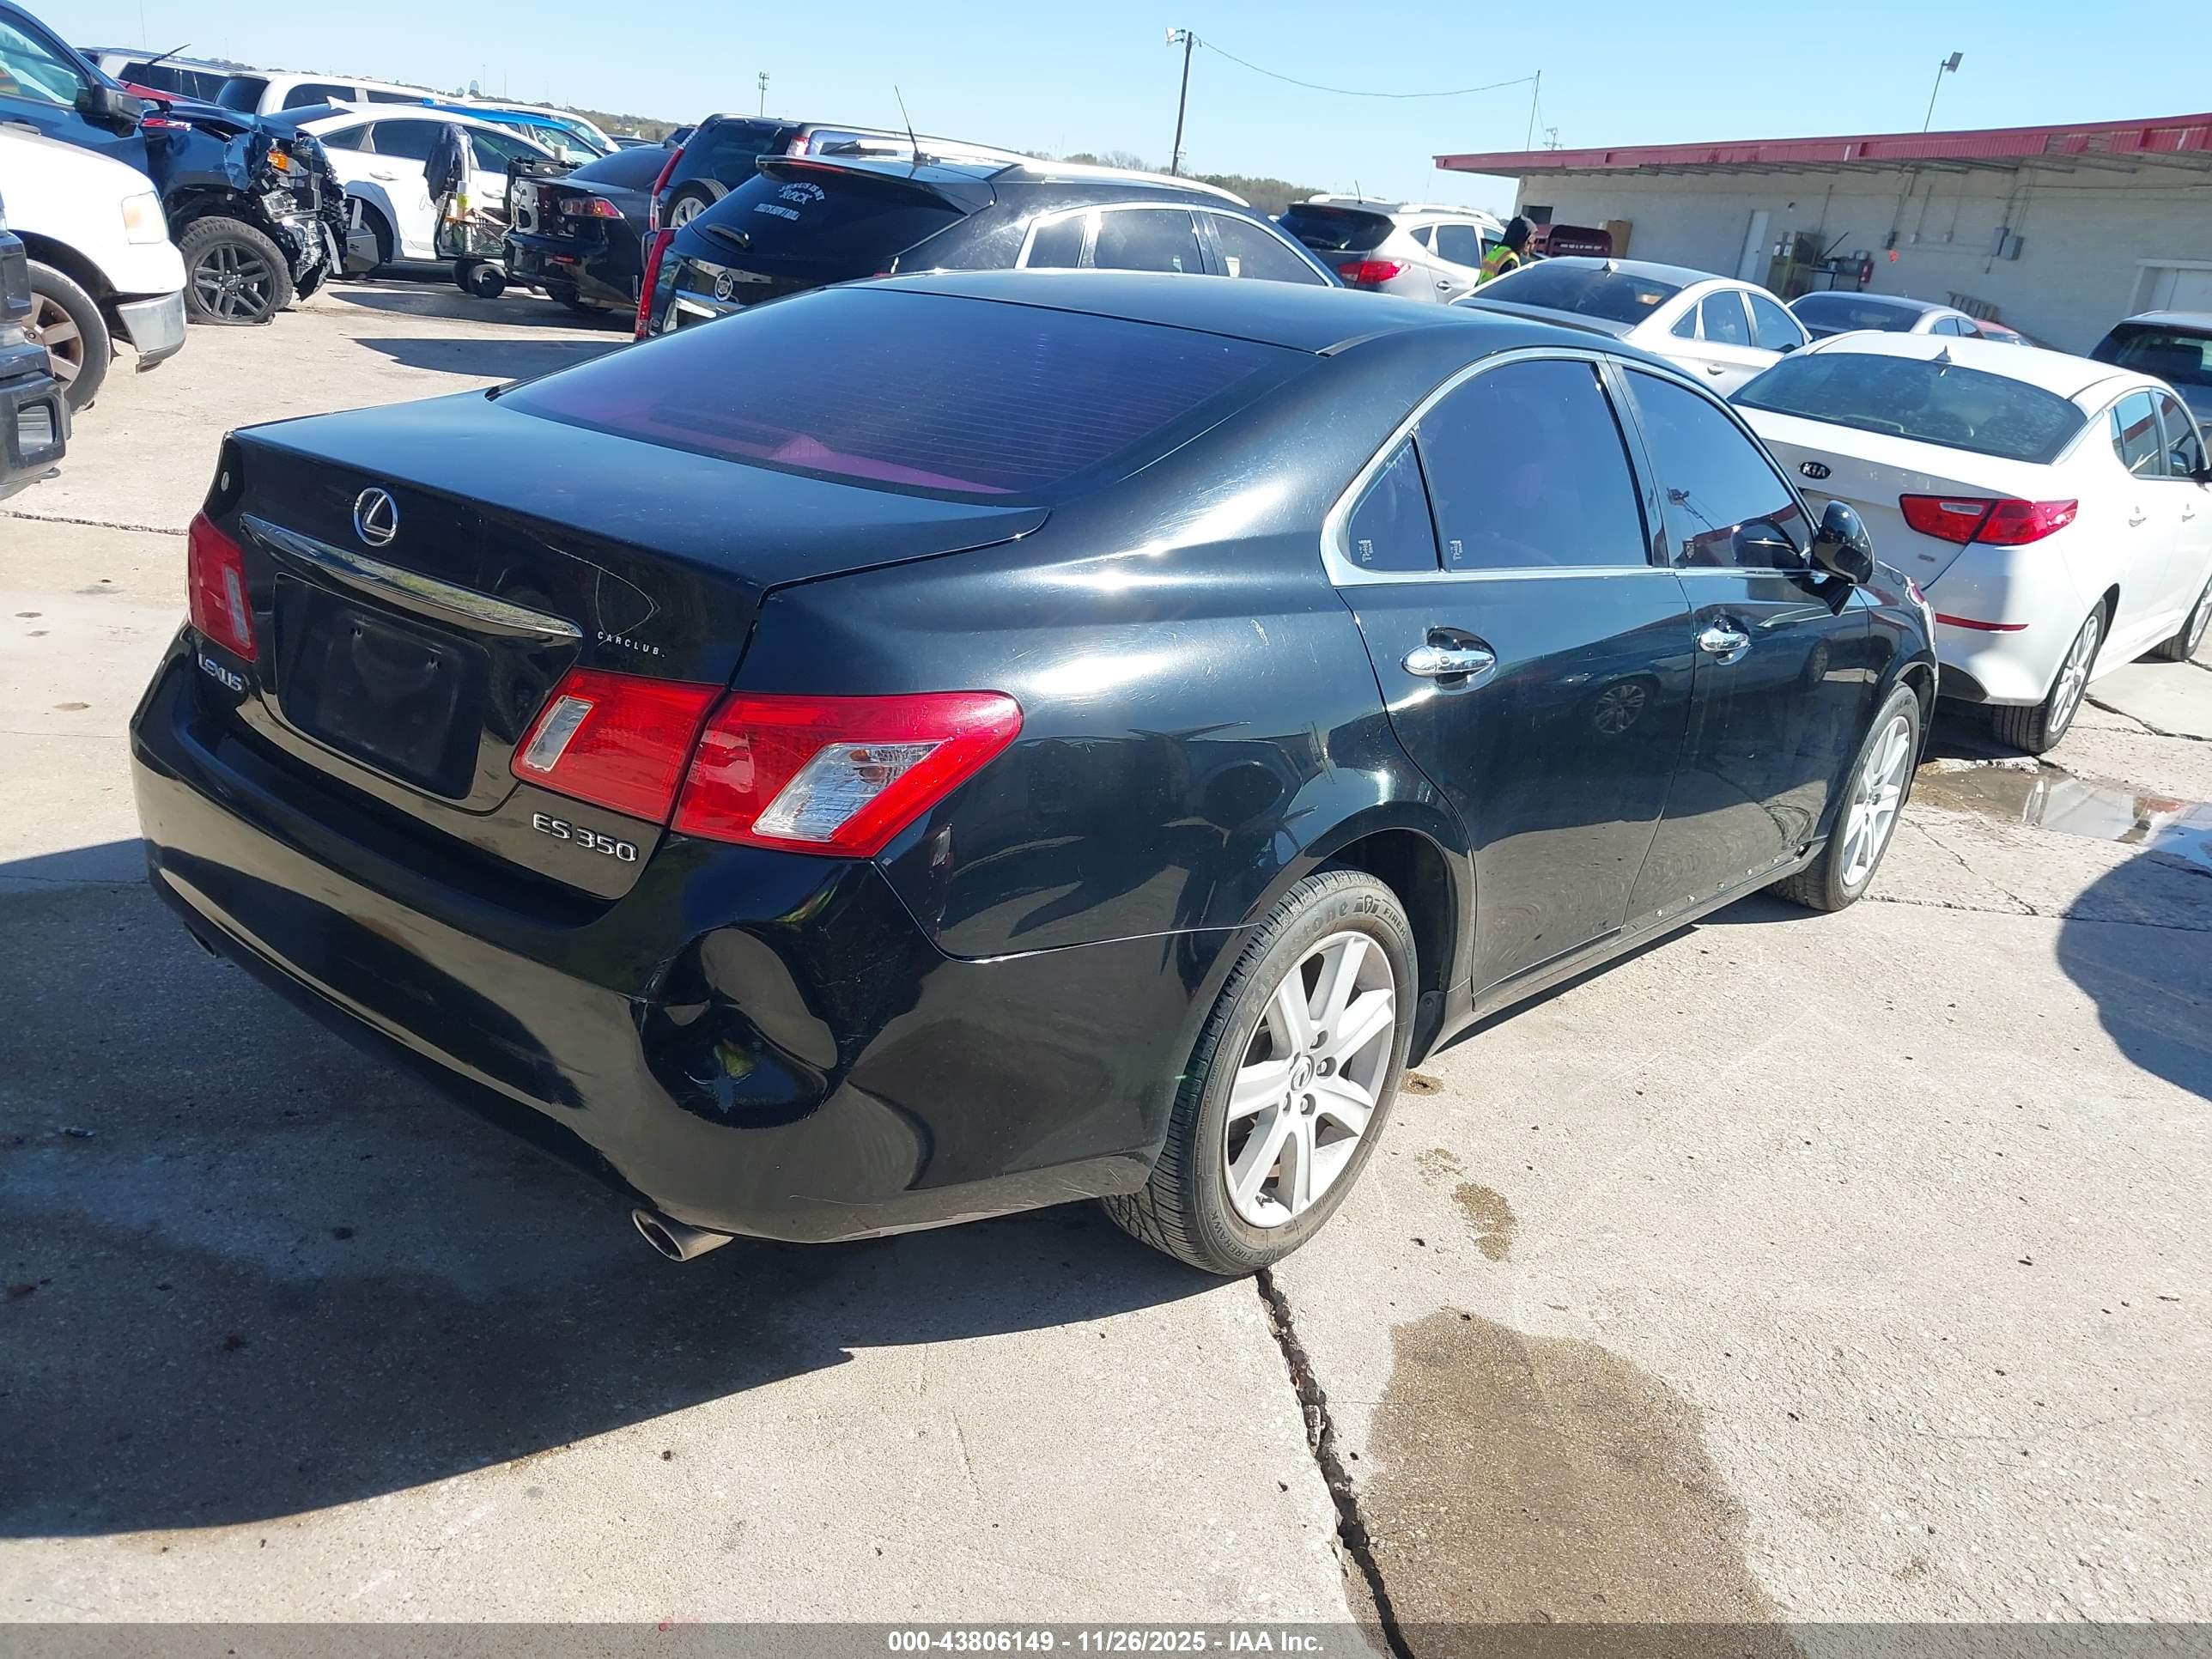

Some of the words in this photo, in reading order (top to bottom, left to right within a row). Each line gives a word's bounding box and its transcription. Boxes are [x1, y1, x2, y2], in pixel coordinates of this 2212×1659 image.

[1802, 463, 1826, 477] KIA
[198, 653, 242, 691] LEXUS
[532, 812, 571, 839] ES
[576, 827, 638, 862] 350
